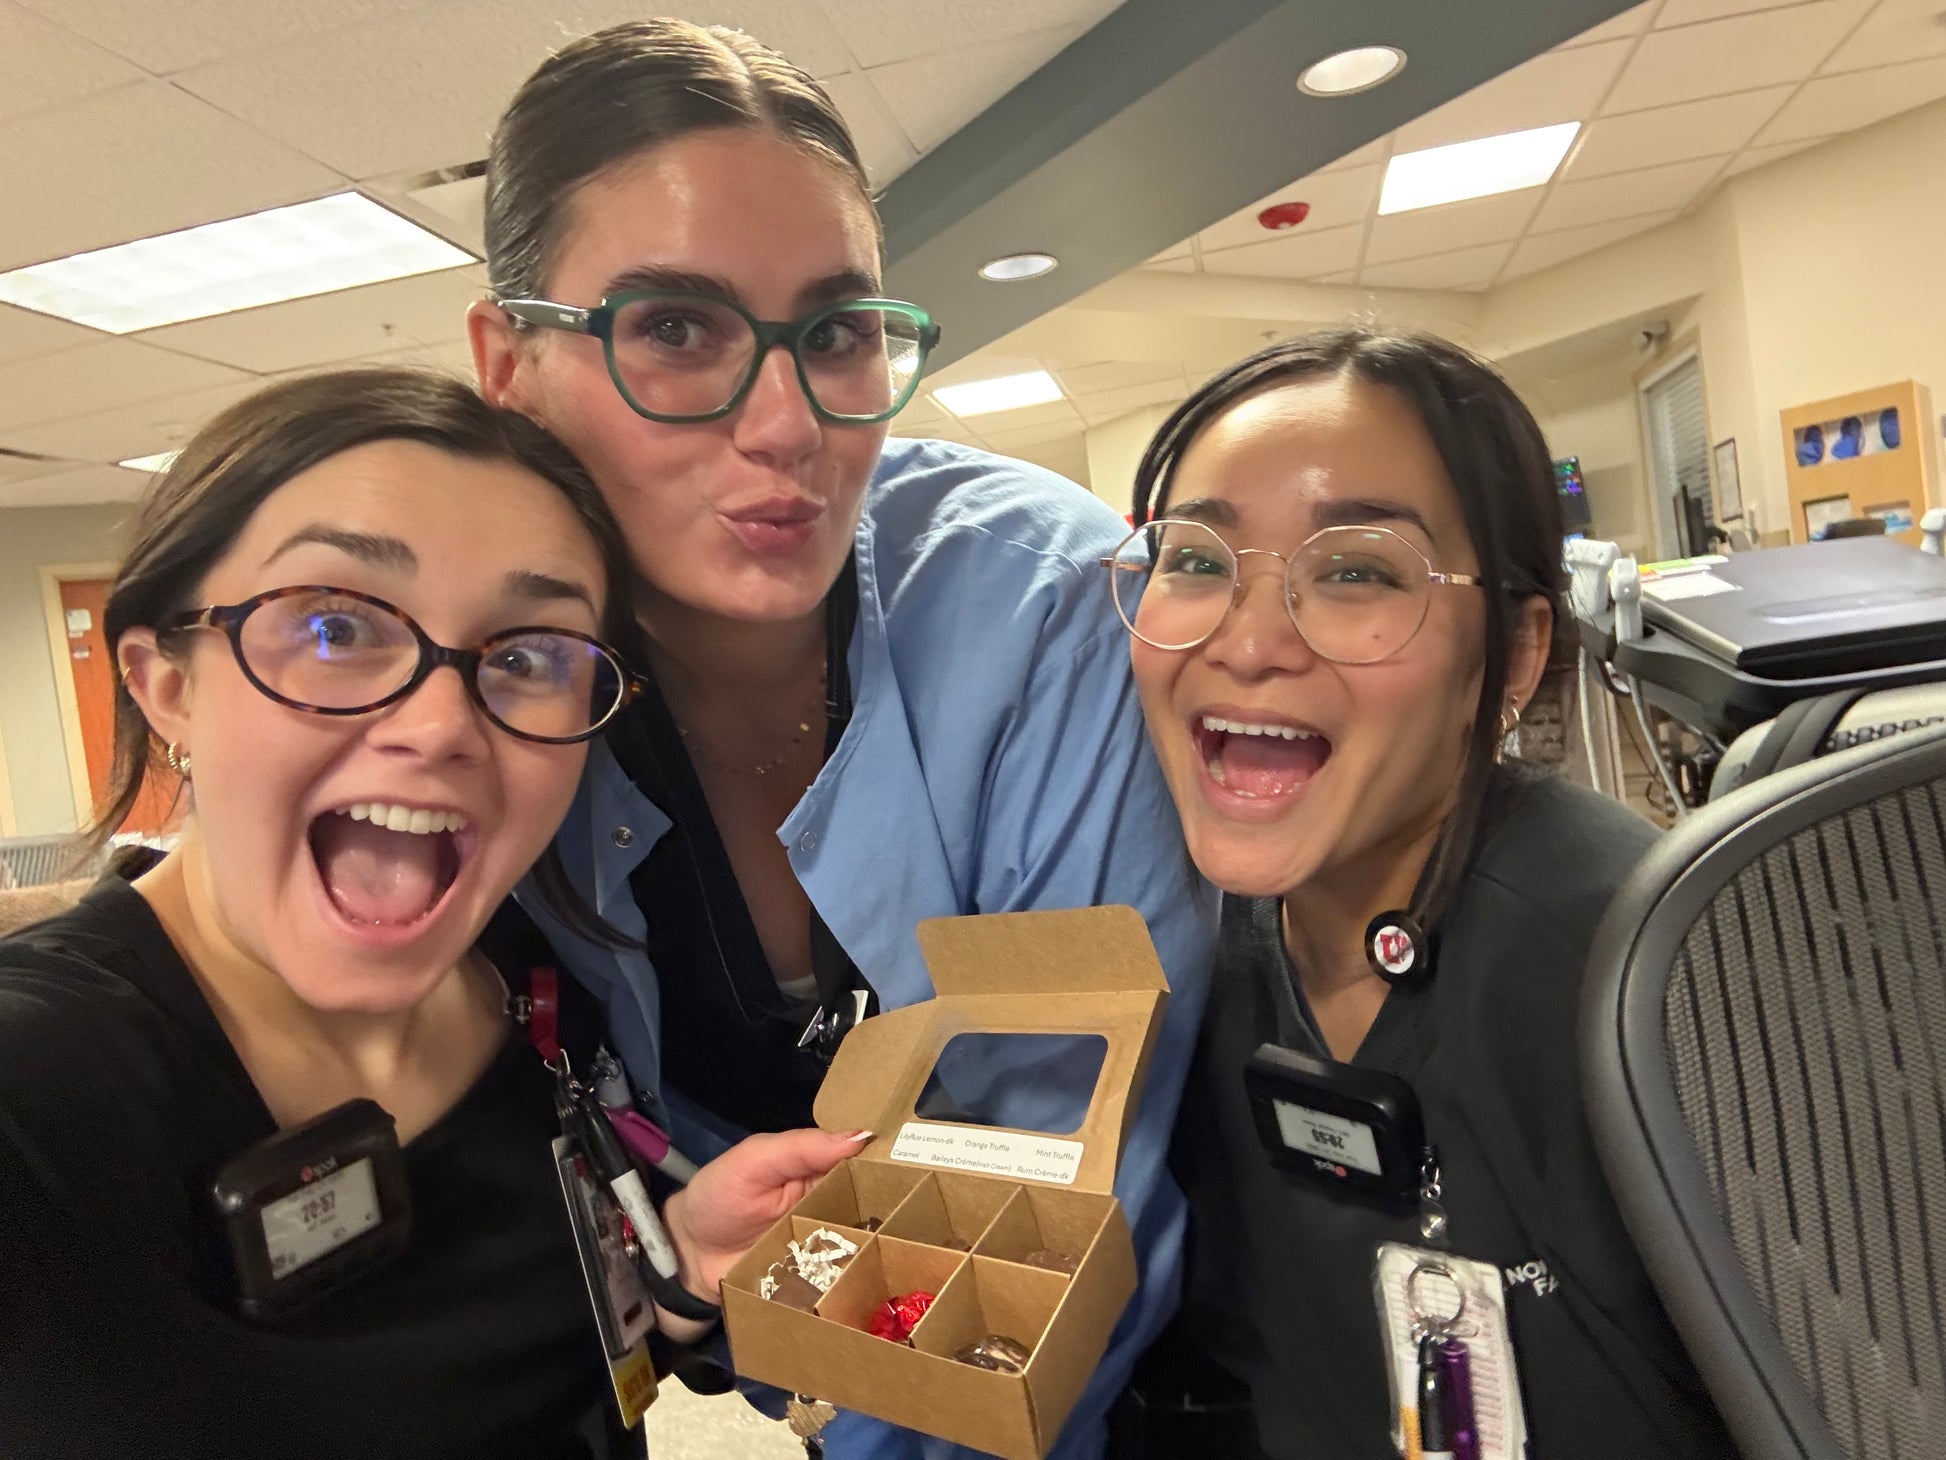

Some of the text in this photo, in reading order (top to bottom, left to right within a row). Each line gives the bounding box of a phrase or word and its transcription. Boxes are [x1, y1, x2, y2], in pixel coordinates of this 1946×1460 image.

[964, 1140, 1010, 1152] Orange Truffle
[893, 1149, 919, 1158] Caramel
[931, 1154, 954, 1164] Baileys
[1036, 1149, 1075, 1161] Mint Truffle
[1017, 1165, 1034, 1175] Rum
